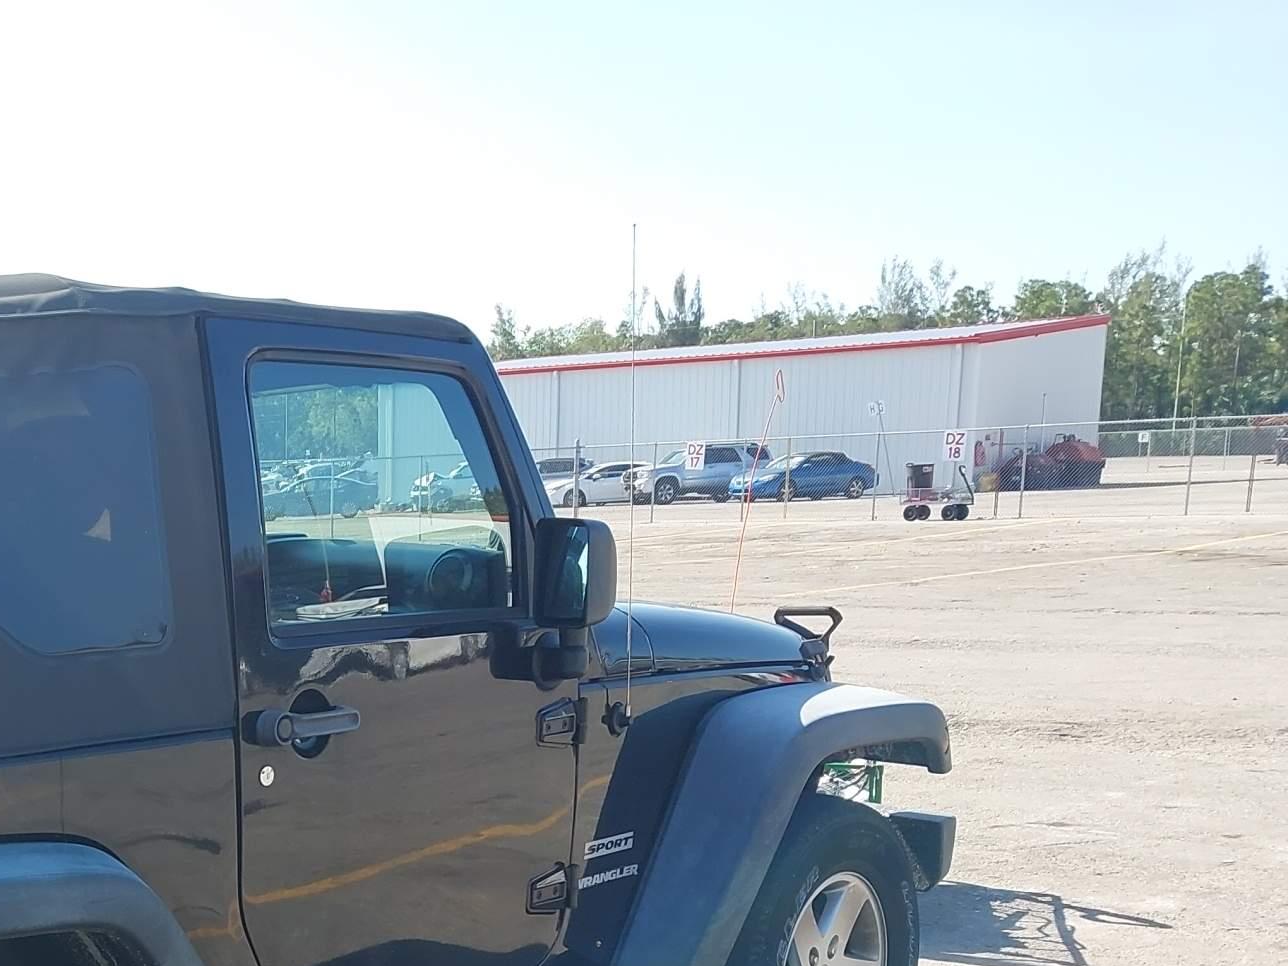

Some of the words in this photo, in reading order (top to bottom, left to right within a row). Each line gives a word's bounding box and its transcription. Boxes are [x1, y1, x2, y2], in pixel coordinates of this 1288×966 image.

[945, 432, 965, 446] DZ
[688, 443, 704, 456] DZ
[948, 446, 961, 459] 18
[690, 456, 700, 468] 17
[586, 836, 633, 856] SPORT
